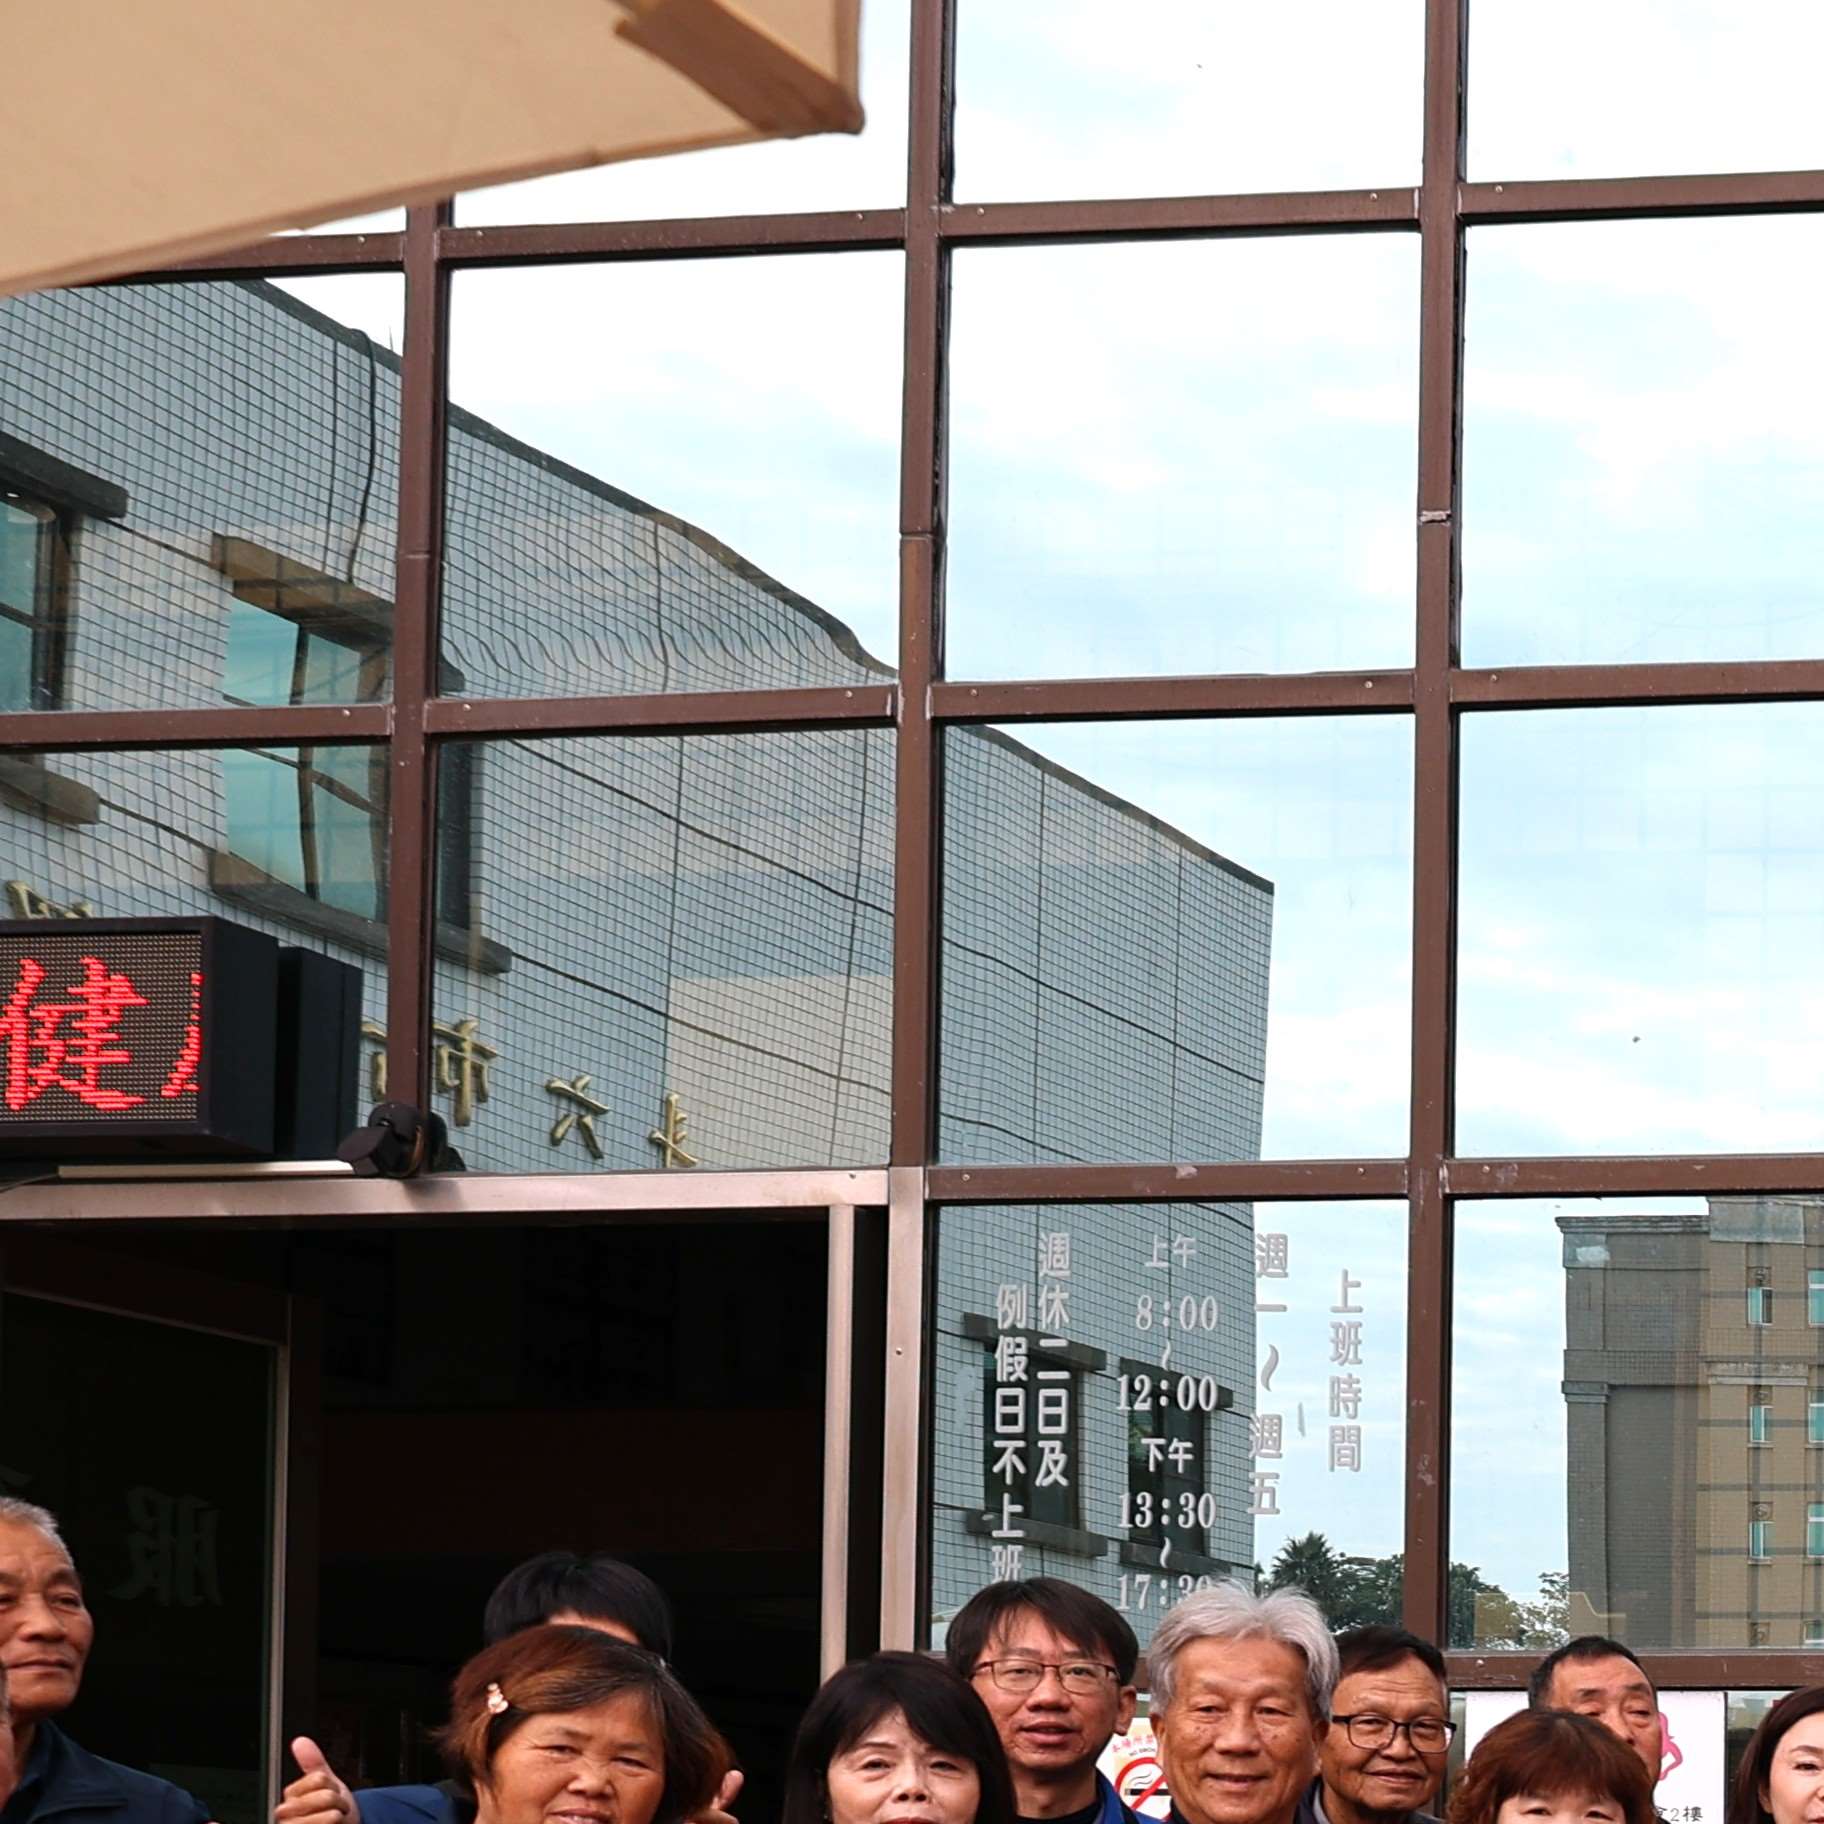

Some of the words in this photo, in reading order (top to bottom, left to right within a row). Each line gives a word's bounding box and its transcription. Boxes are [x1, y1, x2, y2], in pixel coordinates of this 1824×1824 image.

[1145, 1235, 1197, 1269] 上午
[1135, 1295, 1218, 1331] 8:00
[1034, 1233, 1072, 1488] 週休二日及
[1329, 1269, 1363, 1474] 上班時間
[1117, 1376, 1218, 1413] 12:00
[1139, 1437, 1195, 1475] 下午
[1118, 1493, 1218, 1528] 13:30
